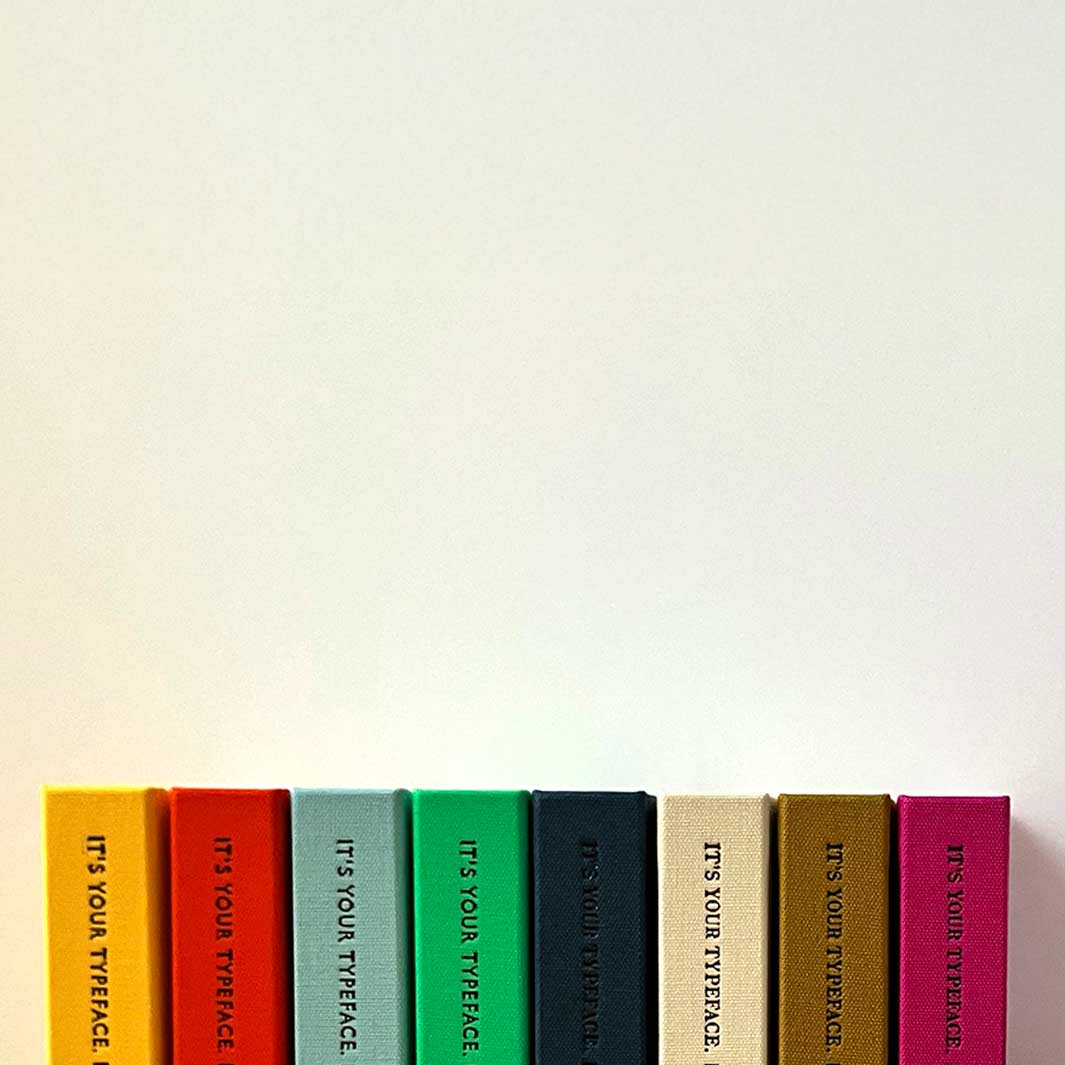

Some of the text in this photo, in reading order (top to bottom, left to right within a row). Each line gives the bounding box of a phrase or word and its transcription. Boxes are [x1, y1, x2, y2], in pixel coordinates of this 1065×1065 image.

[86, 834, 107, 875] IT'S
[214, 836, 233, 875] IT'S
[336, 838, 355, 878] IT'S
[459, 839, 478, 878] IT'S
[703, 841, 722, 882] IT'S
[825, 842, 845, 882] IT'S
[945, 844, 964, 883] IT'S
[88, 881, 107, 941] YOUR
[214, 882, 233, 941] YOUR
[337, 884, 356, 943] YOUR
[460, 885, 479, 944] YOUR
[582, 885, 600, 939] YOUR
[704, 886, 721, 940] YOUR
[825, 888, 843, 939] YOUR
[945, 889, 964, 942] YOUR
[703, 945, 722, 1053] TYPEFACE.
[824, 945, 843, 1053] TYPEFACE.
[944, 948, 964, 1055] TYPEFACE.
